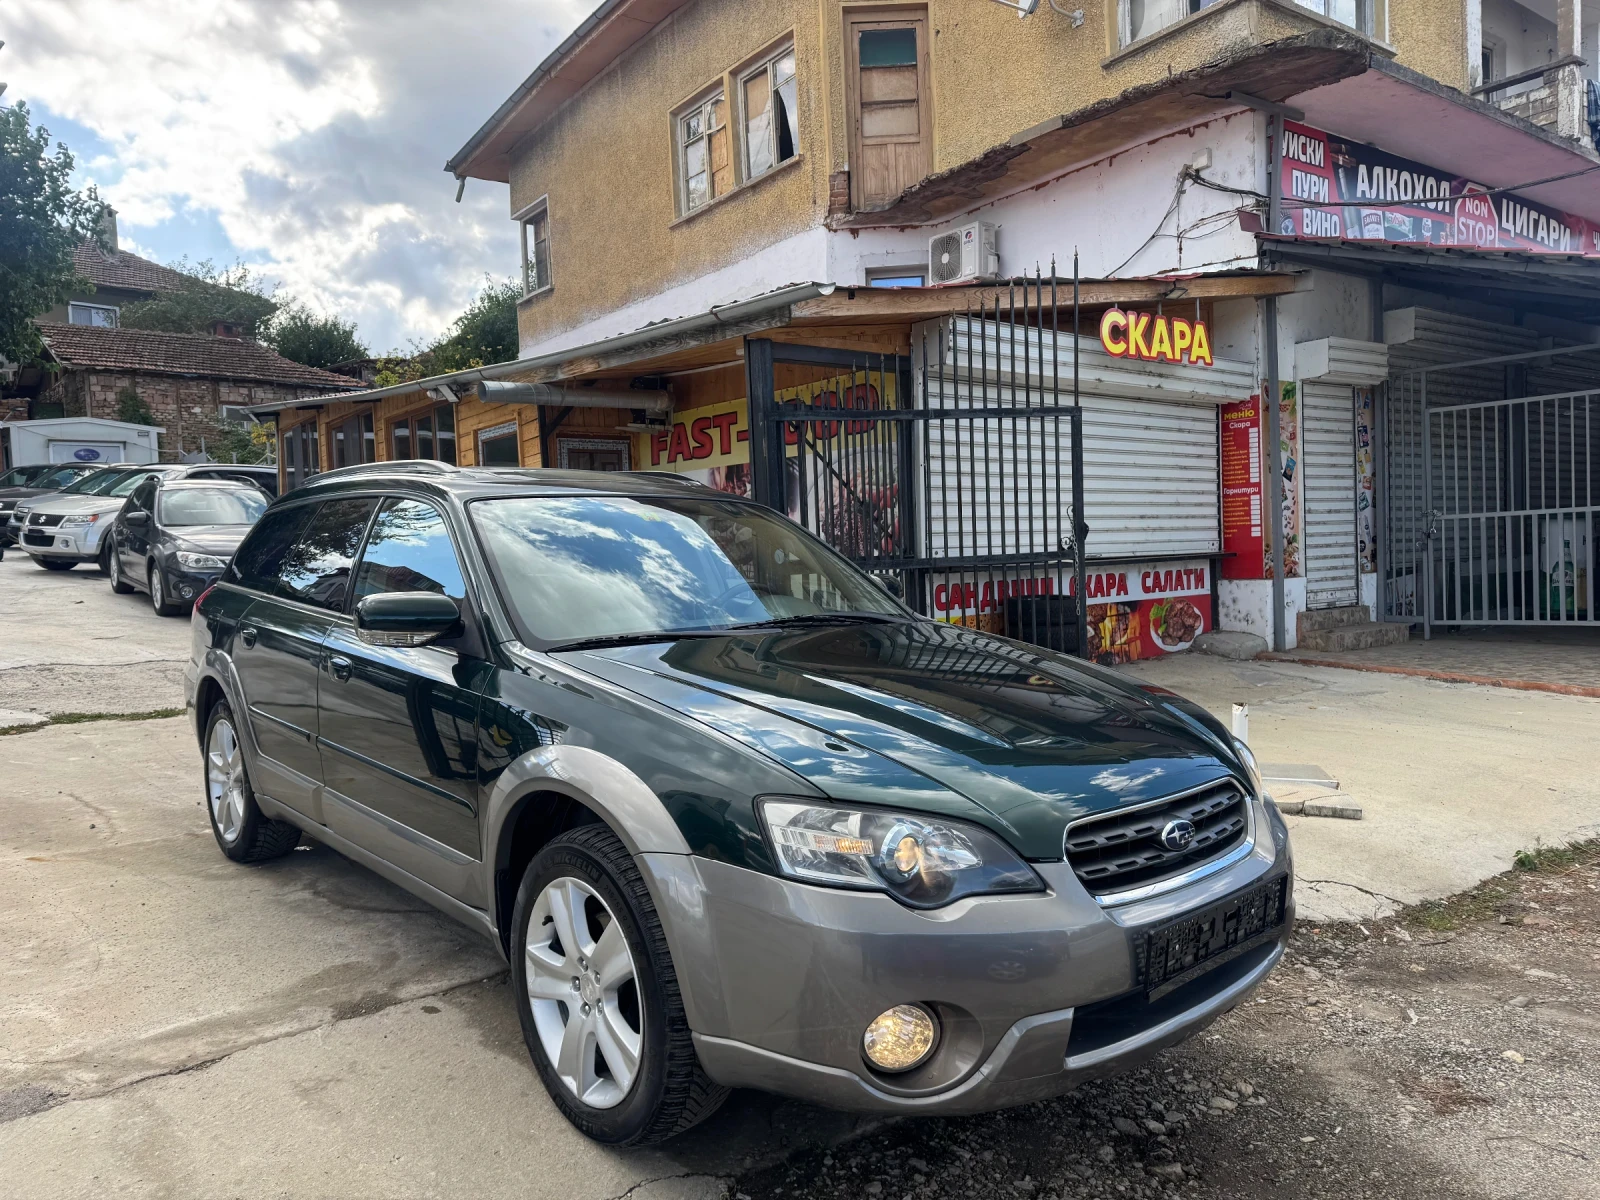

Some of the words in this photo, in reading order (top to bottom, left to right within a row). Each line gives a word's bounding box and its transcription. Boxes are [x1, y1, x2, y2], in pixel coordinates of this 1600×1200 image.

[1291, 168, 1329, 204] ПУРИ
[1302, 207, 1341, 238] ВИНО
[1355, 163, 1451, 213] АЛКОХОЛ
[1501, 197, 1571, 251] ЦИГАРИ
[1464, 197, 1489, 219] NON
[1458, 215, 1497, 247] STOP
[1101, 308, 1213, 366] СКАРА
[1141, 567, 1205, 595] САЛАТИ
[553, 855, 600, 881] MICHELIN
